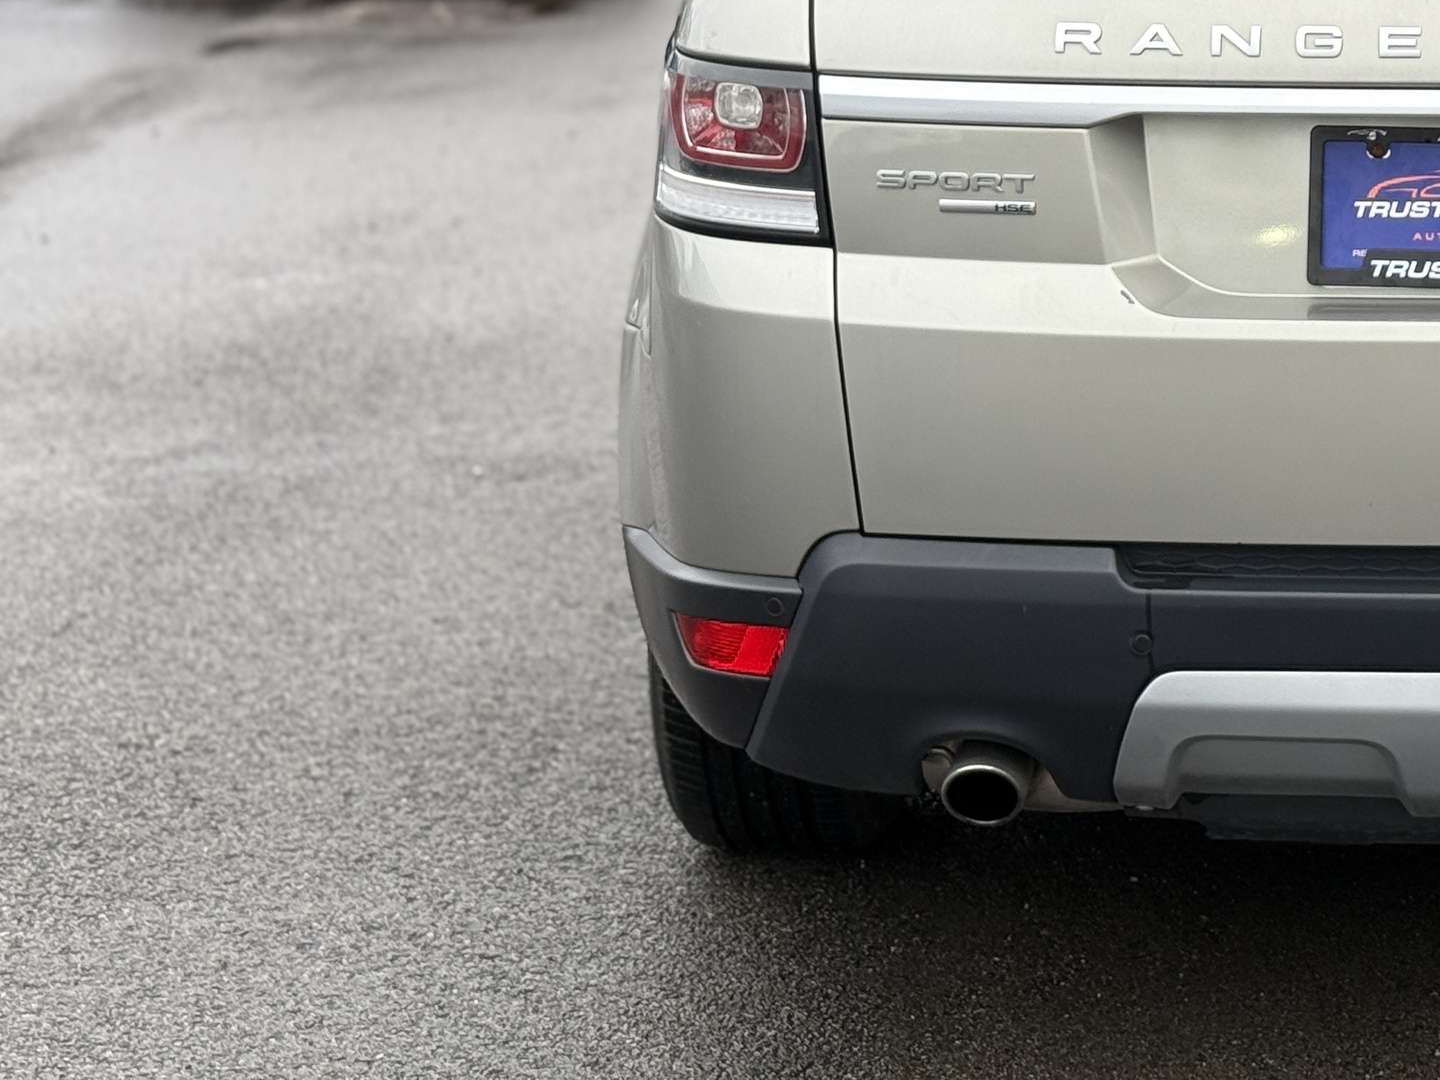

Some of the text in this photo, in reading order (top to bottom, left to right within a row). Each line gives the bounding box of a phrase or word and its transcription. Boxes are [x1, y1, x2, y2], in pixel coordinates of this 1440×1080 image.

[1054, 21, 1423, 58] RANGE
[876, 169, 1036, 194] SPORT
[994, 203, 1032, 215] HSE
